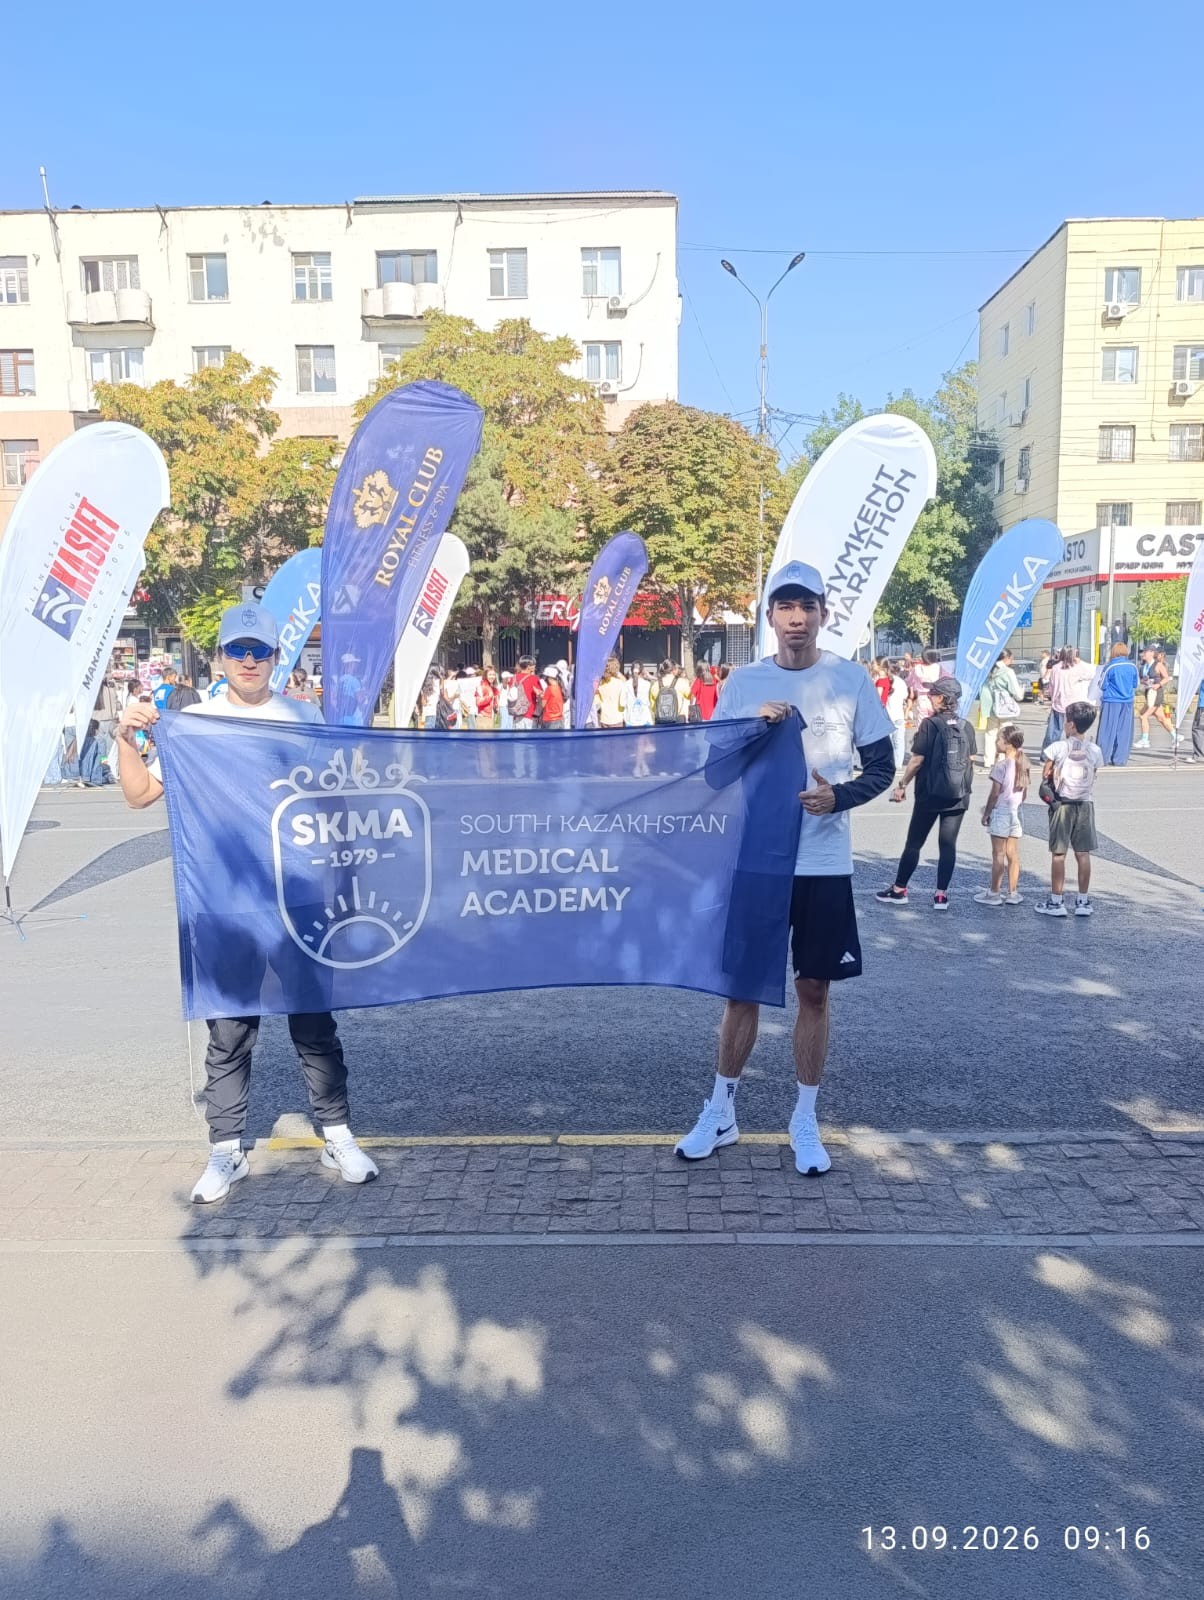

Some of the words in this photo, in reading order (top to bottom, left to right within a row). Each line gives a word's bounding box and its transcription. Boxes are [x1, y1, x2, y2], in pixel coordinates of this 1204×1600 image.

[50, 496, 120, 601] KASIET
[374, 512, 418, 588] ROYAL
[408, 447, 444, 507] CLUB
[408, 520, 434, 568] FITNESS
[434, 483, 449, 506] SPA
[825, 464, 895, 608] HYMKENT
[826, 468, 917, 638] MARATHON
[420, 568, 448, 617] KASIET
[598, 600, 618, 636] ROYAL
[615, 566, 631, 596] CLUB
[291, 808, 413, 847] SKMA
[460, 813, 551, 835] SOUTH
[560, 813, 727, 835] KAZAKHSTAN
[460, 848, 619, 877] MEDICAL
[460, 886, 631, 918] ACADEMY
